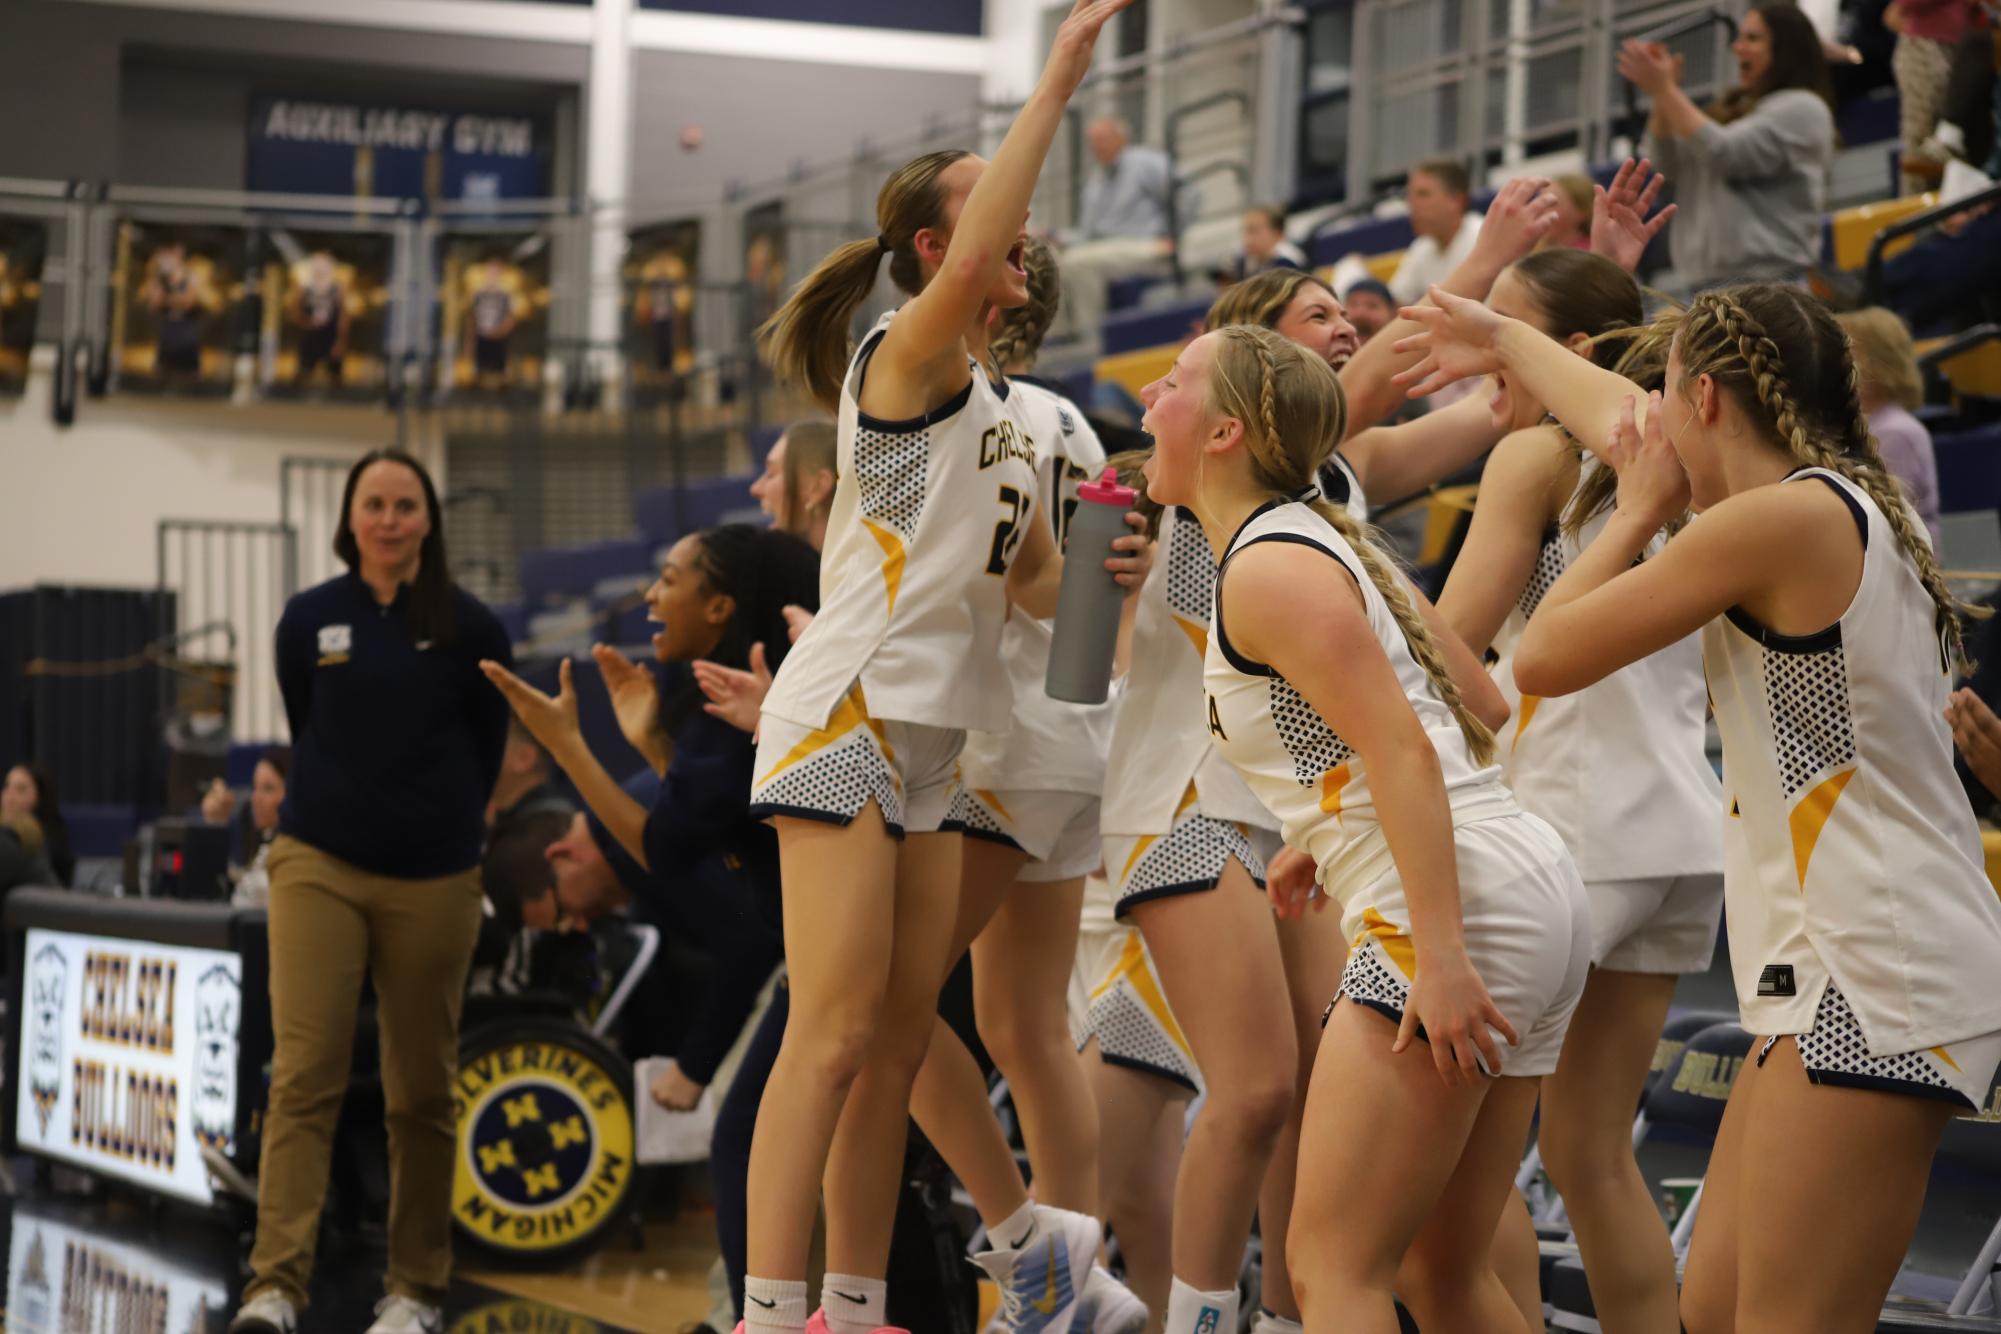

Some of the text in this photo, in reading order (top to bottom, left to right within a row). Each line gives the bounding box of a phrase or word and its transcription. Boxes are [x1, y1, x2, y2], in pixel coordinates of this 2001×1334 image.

[265, 100, 533, 158] AUXILIARY GYM
[80, 949, 178, 1056] CHELSEA
[71, 1057, 178, 1173] BULLDOGS
[455, 1045, 614, 1119] OLVERINES
[460, 1151, 624, 1240] MICHIGAN
